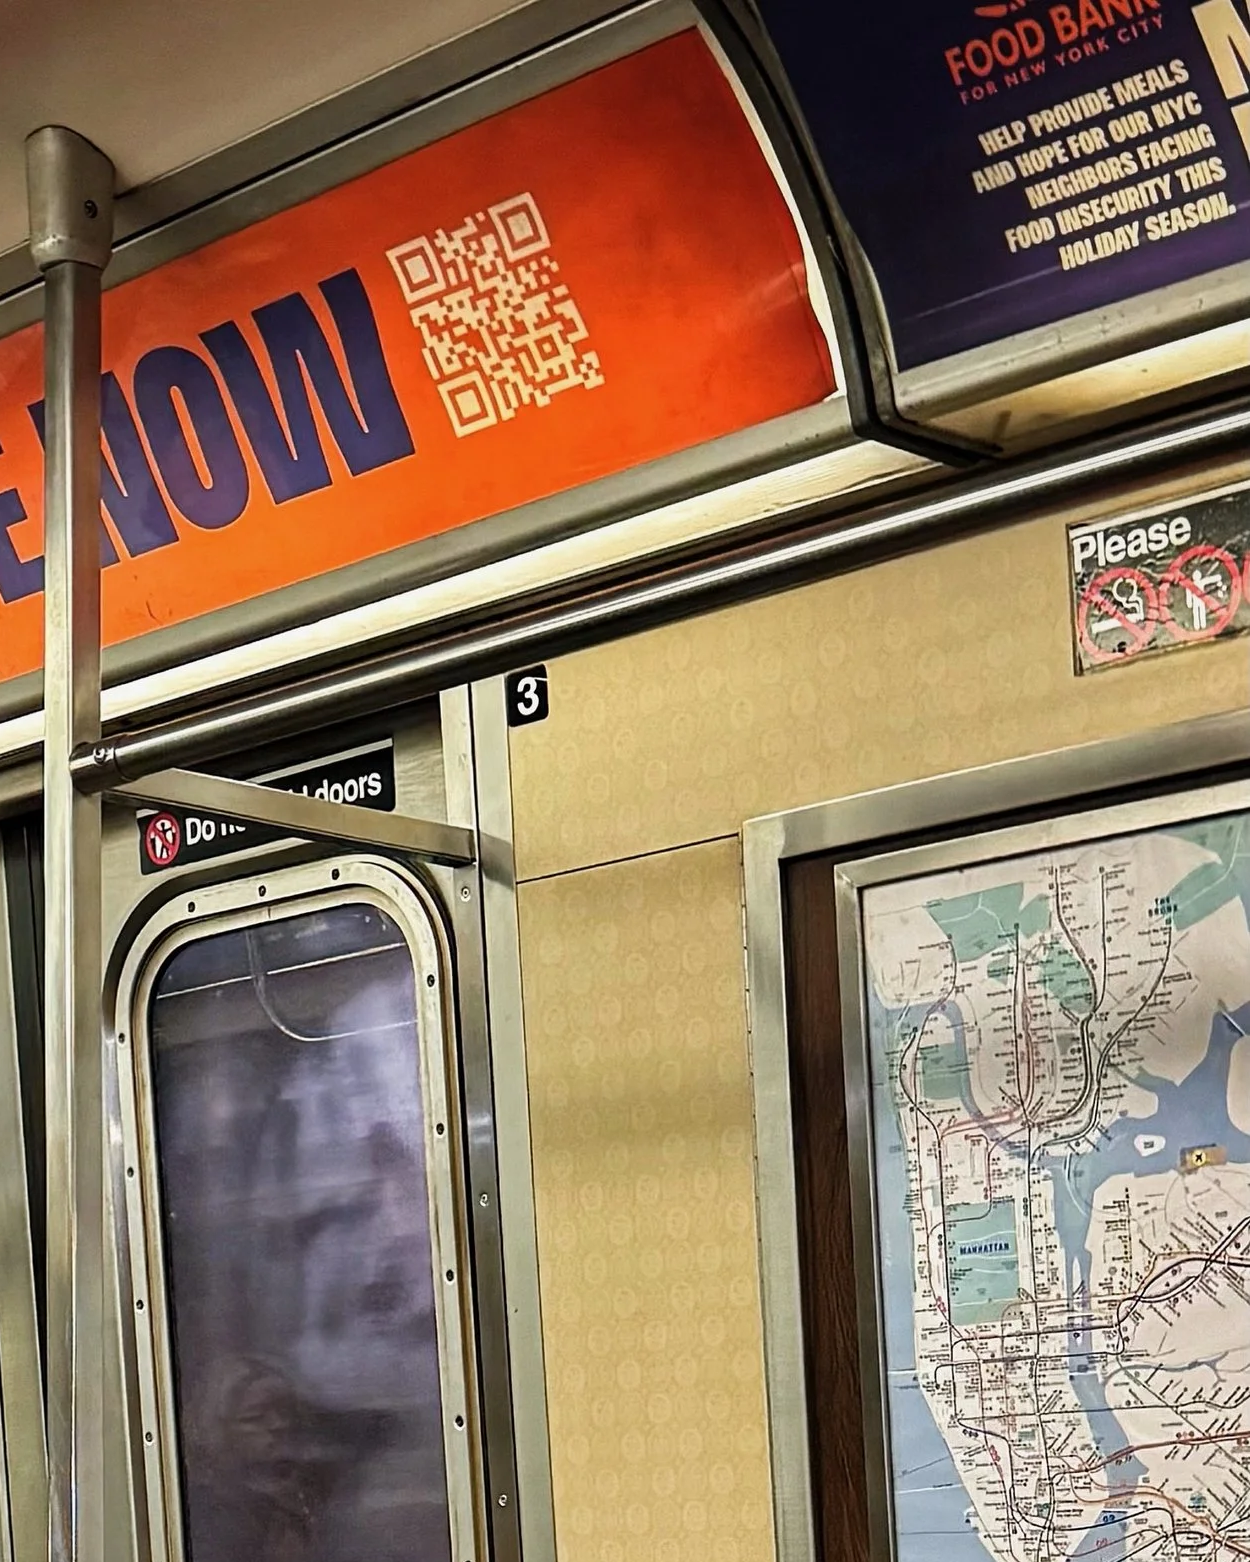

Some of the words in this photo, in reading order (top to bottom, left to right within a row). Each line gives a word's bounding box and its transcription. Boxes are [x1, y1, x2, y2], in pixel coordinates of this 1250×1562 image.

[944, 18, 1046, 86] FOOD
[958, 80, 998, 106] FOR
[1003, 60, 1047, 89] NEW
[1054, 37, 1111, 68] YORK
[1116, 13, 1165, 45] CITY
[971, 160, 1017, 194] AND
[1014, 144, 1069, 179] HOPE
[1066, 126, 1109, 159] FOR
[1107, 110, 1153, 144] OUR
[1150, 91, 1202, 129] NYC
[978, 120, 1027, 156] HELP
[1027, 86, 1115, 138] PROVIDE
[1112, 58, 1190, 107] MEALS
[1004, 217, 1056, 253] FOOD
[1055, 174, 1172, 236] INSECURITY
[1174, 156, 1227, 194] THIS
[1024, 151, 1138, 210] NEIGHBORS
[1136, 123, 1217, 171] FACING
[1058, 221, 1141, 271] HOLIDAY
[1144, 191, 1237, 242] SEASON.
[28, 267, 415, 570] NOW
[1072, 516, 1192, 573] Please
[516, 677, 540, 716] 3
[185, 817, 216, 846] Do
[314, 772, 382, 804] doors
[959, 1242, 1009, 1255] MANHATTAN
